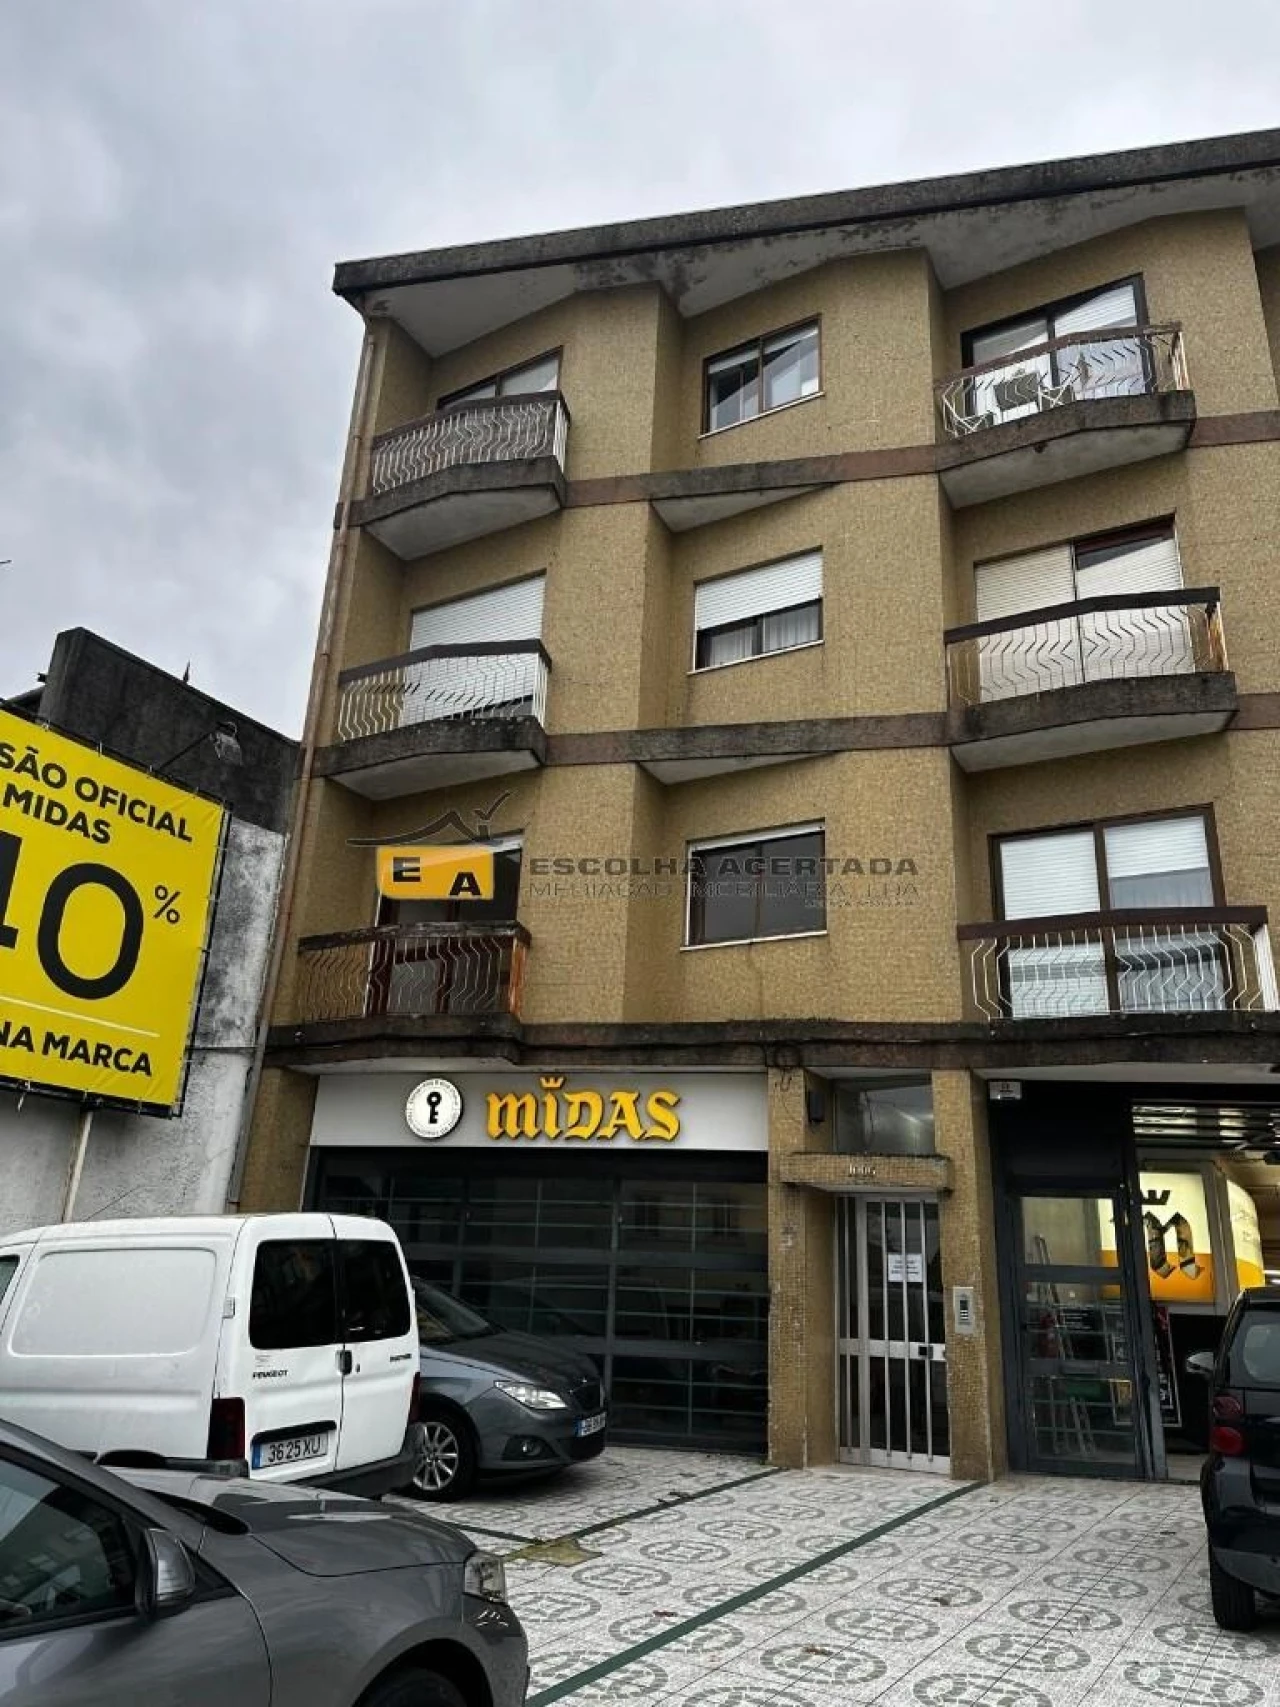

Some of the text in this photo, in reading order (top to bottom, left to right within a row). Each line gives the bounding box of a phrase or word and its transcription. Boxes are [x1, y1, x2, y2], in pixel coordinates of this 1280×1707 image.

[3, 783, 111, 844] MIDAS
[75, 776, 194, 843] OFICIAL
[42, 1031, 153, 1078] MARCA
